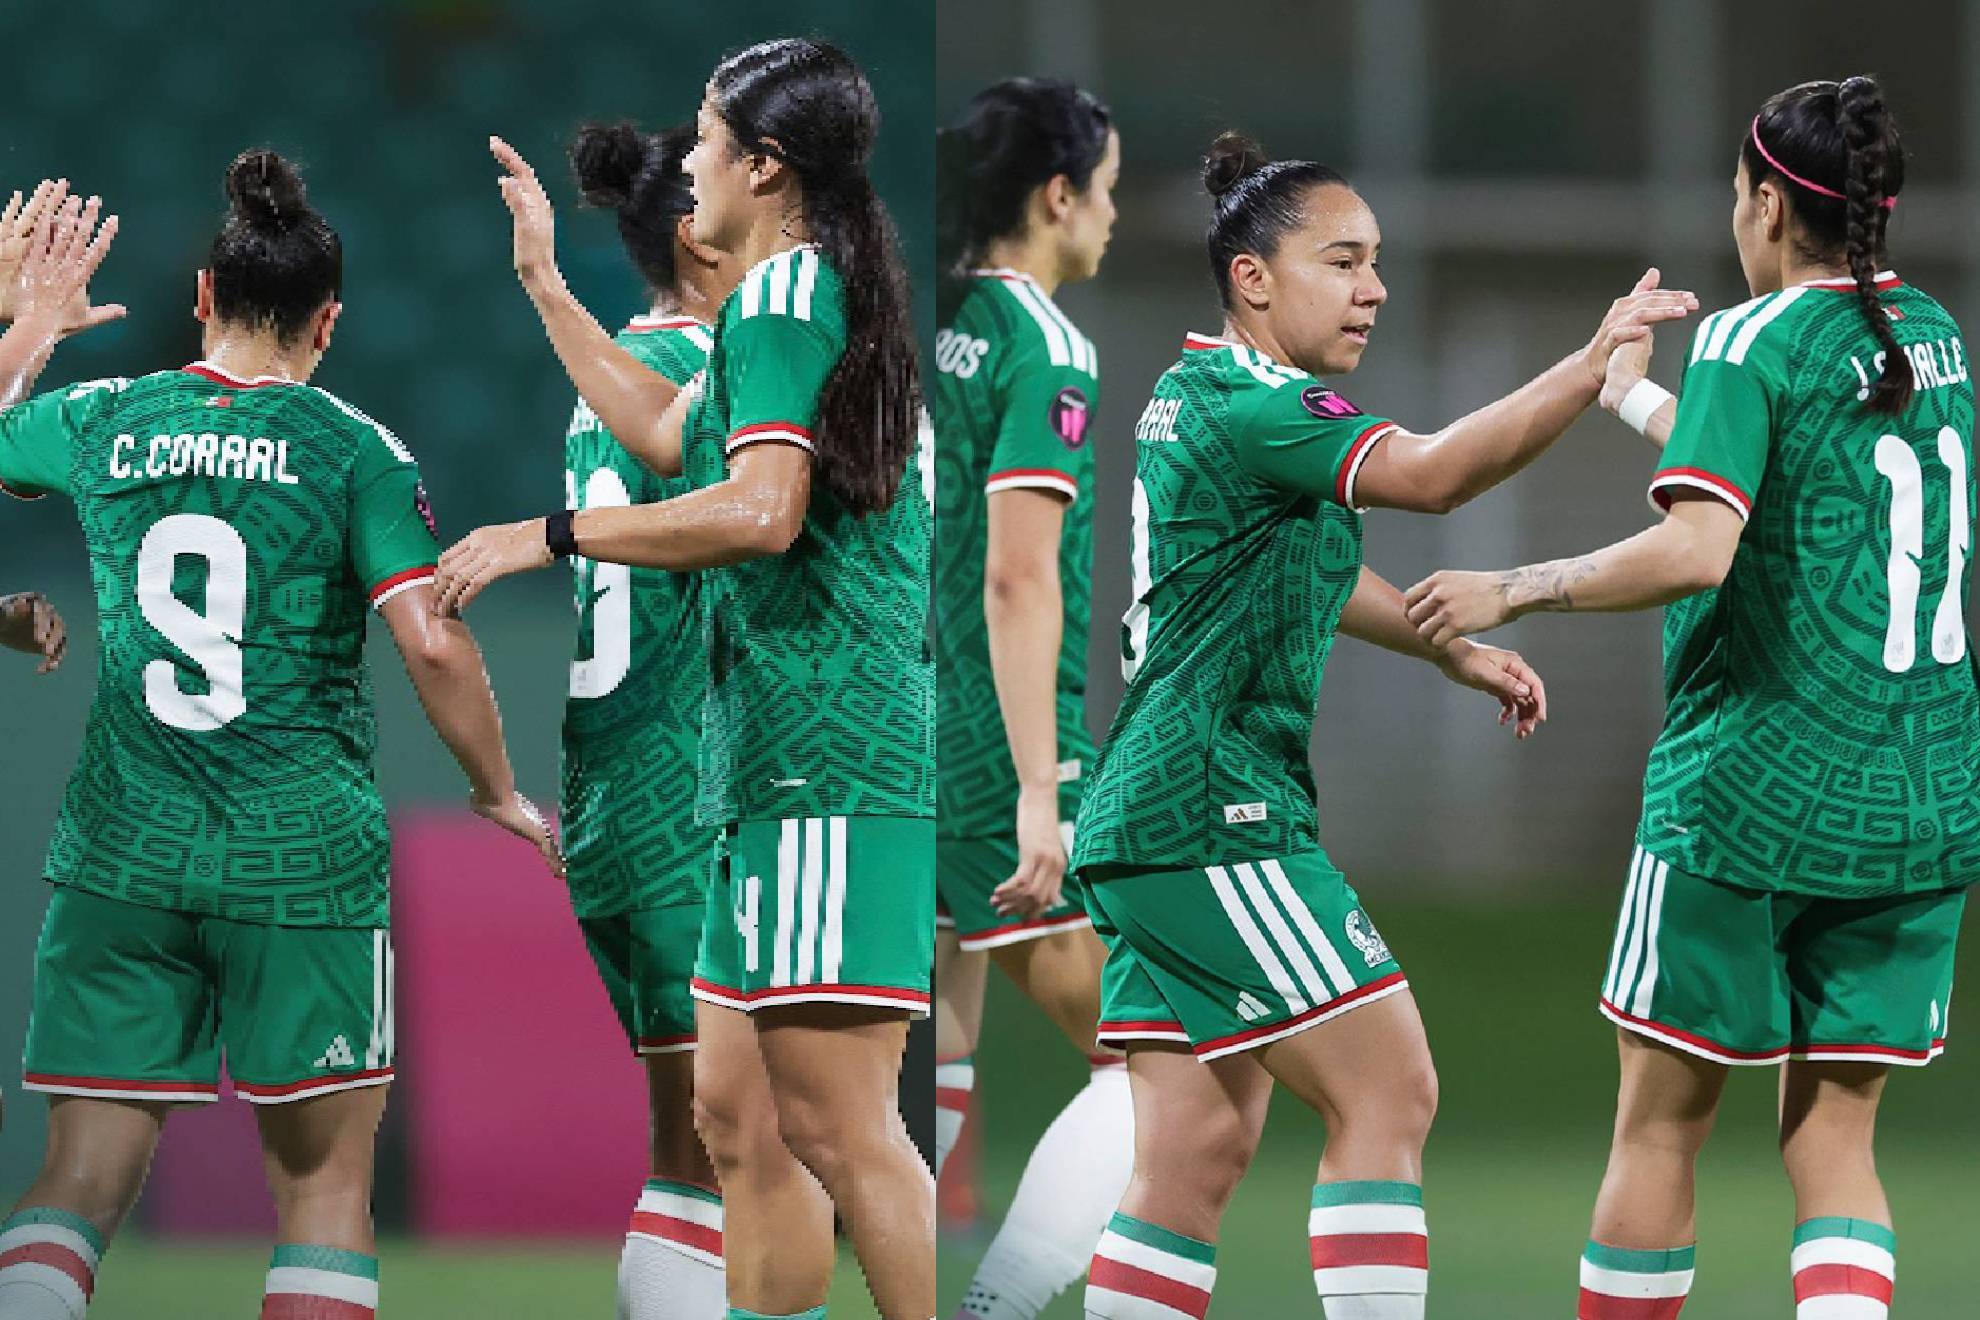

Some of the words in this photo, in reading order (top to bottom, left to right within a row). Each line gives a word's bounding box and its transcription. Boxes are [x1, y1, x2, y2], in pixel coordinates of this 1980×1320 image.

[109, 434, 298, 484] C.CORRAL
[1874, 425, 1970, 673] 11
[136, 513, 247, 731] 9
